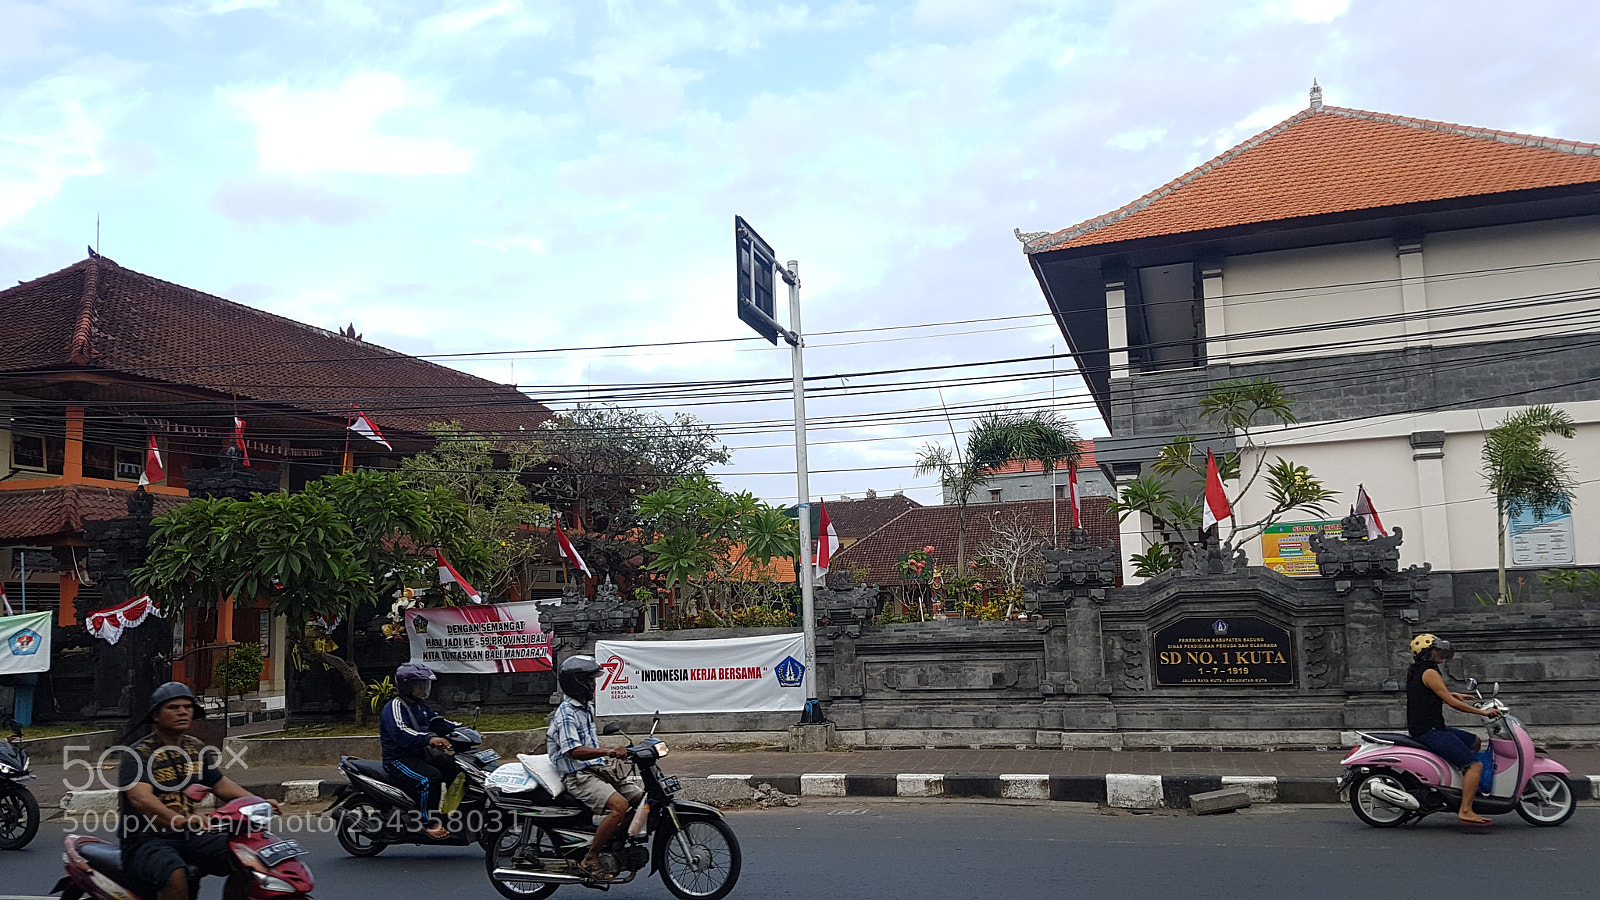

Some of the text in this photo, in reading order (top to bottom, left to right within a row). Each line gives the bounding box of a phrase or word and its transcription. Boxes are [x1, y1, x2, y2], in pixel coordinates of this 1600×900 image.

[447, 620, 525, 634] DENGAN SEMANGAT
[425, 638, 443, 648] HARI
[444, 637, 461, 648] JADI
[463, 637, 474, 647] KE
[480, 636, 490, 646] 59
[492, 634, 529, 645] PROVINSI
[530, 633, 548, 643] BALI
[422, 651, 440, 660] KITA
[440, 650, 484, 660] TUNTASKAN
[484, 649, 502, 659] BALI
[503, 648, 540, 658] MANDARA
[1159, 651, 1288, 665] SD NO. 1 KUTA
[690, 667, 717, 681] KERJA
